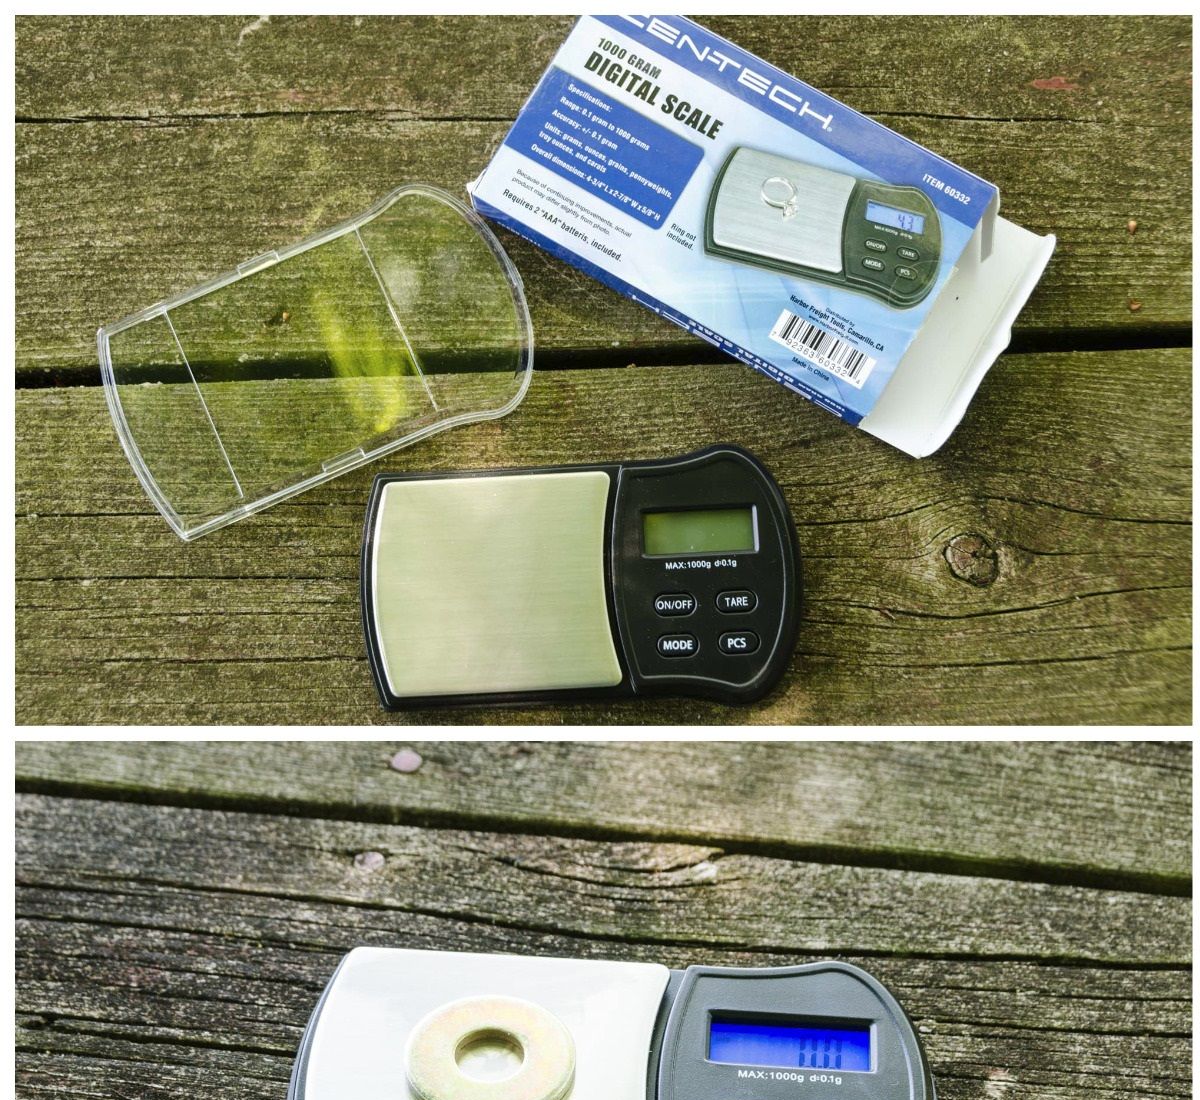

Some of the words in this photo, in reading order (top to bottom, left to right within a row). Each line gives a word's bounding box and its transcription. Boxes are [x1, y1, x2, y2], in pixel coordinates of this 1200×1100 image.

[597, 37, 628, 61] 1000
[627, 54, 663, 80] GRAM
[567, 83, 614, 113] Specifications:
[583, 51, 663, 107] DIGITAL
[660, 93, 724, 140] SCALE
[551, 110, 583, 131] Accuracy:
[600, 138, 619, 152] gram
[559, 96, 583, 114] Range:
[582, 109, 592, 118] 0.1
[591, 115, 608, 128] gram
[615, 127, 632, 140] 1000
[629, 137, 651, 152] grams
[531, 144, 554, 160] Overall
[551, 156, 588, 180] dimensions:
[538, 131, 552, 142] troy
[575, 152, 588, 162] and
[587, 159, 607, 174] carats
[544, 122, 564, 137] Units:
[562, 133, 585, 150] grams,
[584, 146, 609, 163] ounces,
[608, 159, 630, 175] grains,
[922, 174, 945, 191] ITEM
[943, 185, 971, 205] 60332
[502, 189, 534, 212] Requires
[539, 210, 562, 227] "AAA"
[590, 240, 623, 262] included.
[666, 230, 696, 251] included.
[670, 223, 687, 237] Ring
[686, 232, 697, 241] not
[789, 295, 809, 310] Harbor
[808, 306, 830, 322] Freight
[875, 343, 885, 352] CA
[792, 357, 807, 368] Made
[813, 369, 830, 382] China
[665, 560, 712, 570] MAX:1000g
[656, 599, 693, 610] ON/OFF
[725, 596, 749, 607] TARE
[662, 639, 693, 651] MODE
[727, 637, 747, 649] PCS
[737, 1069, 805, 1083] MAX:1000g
